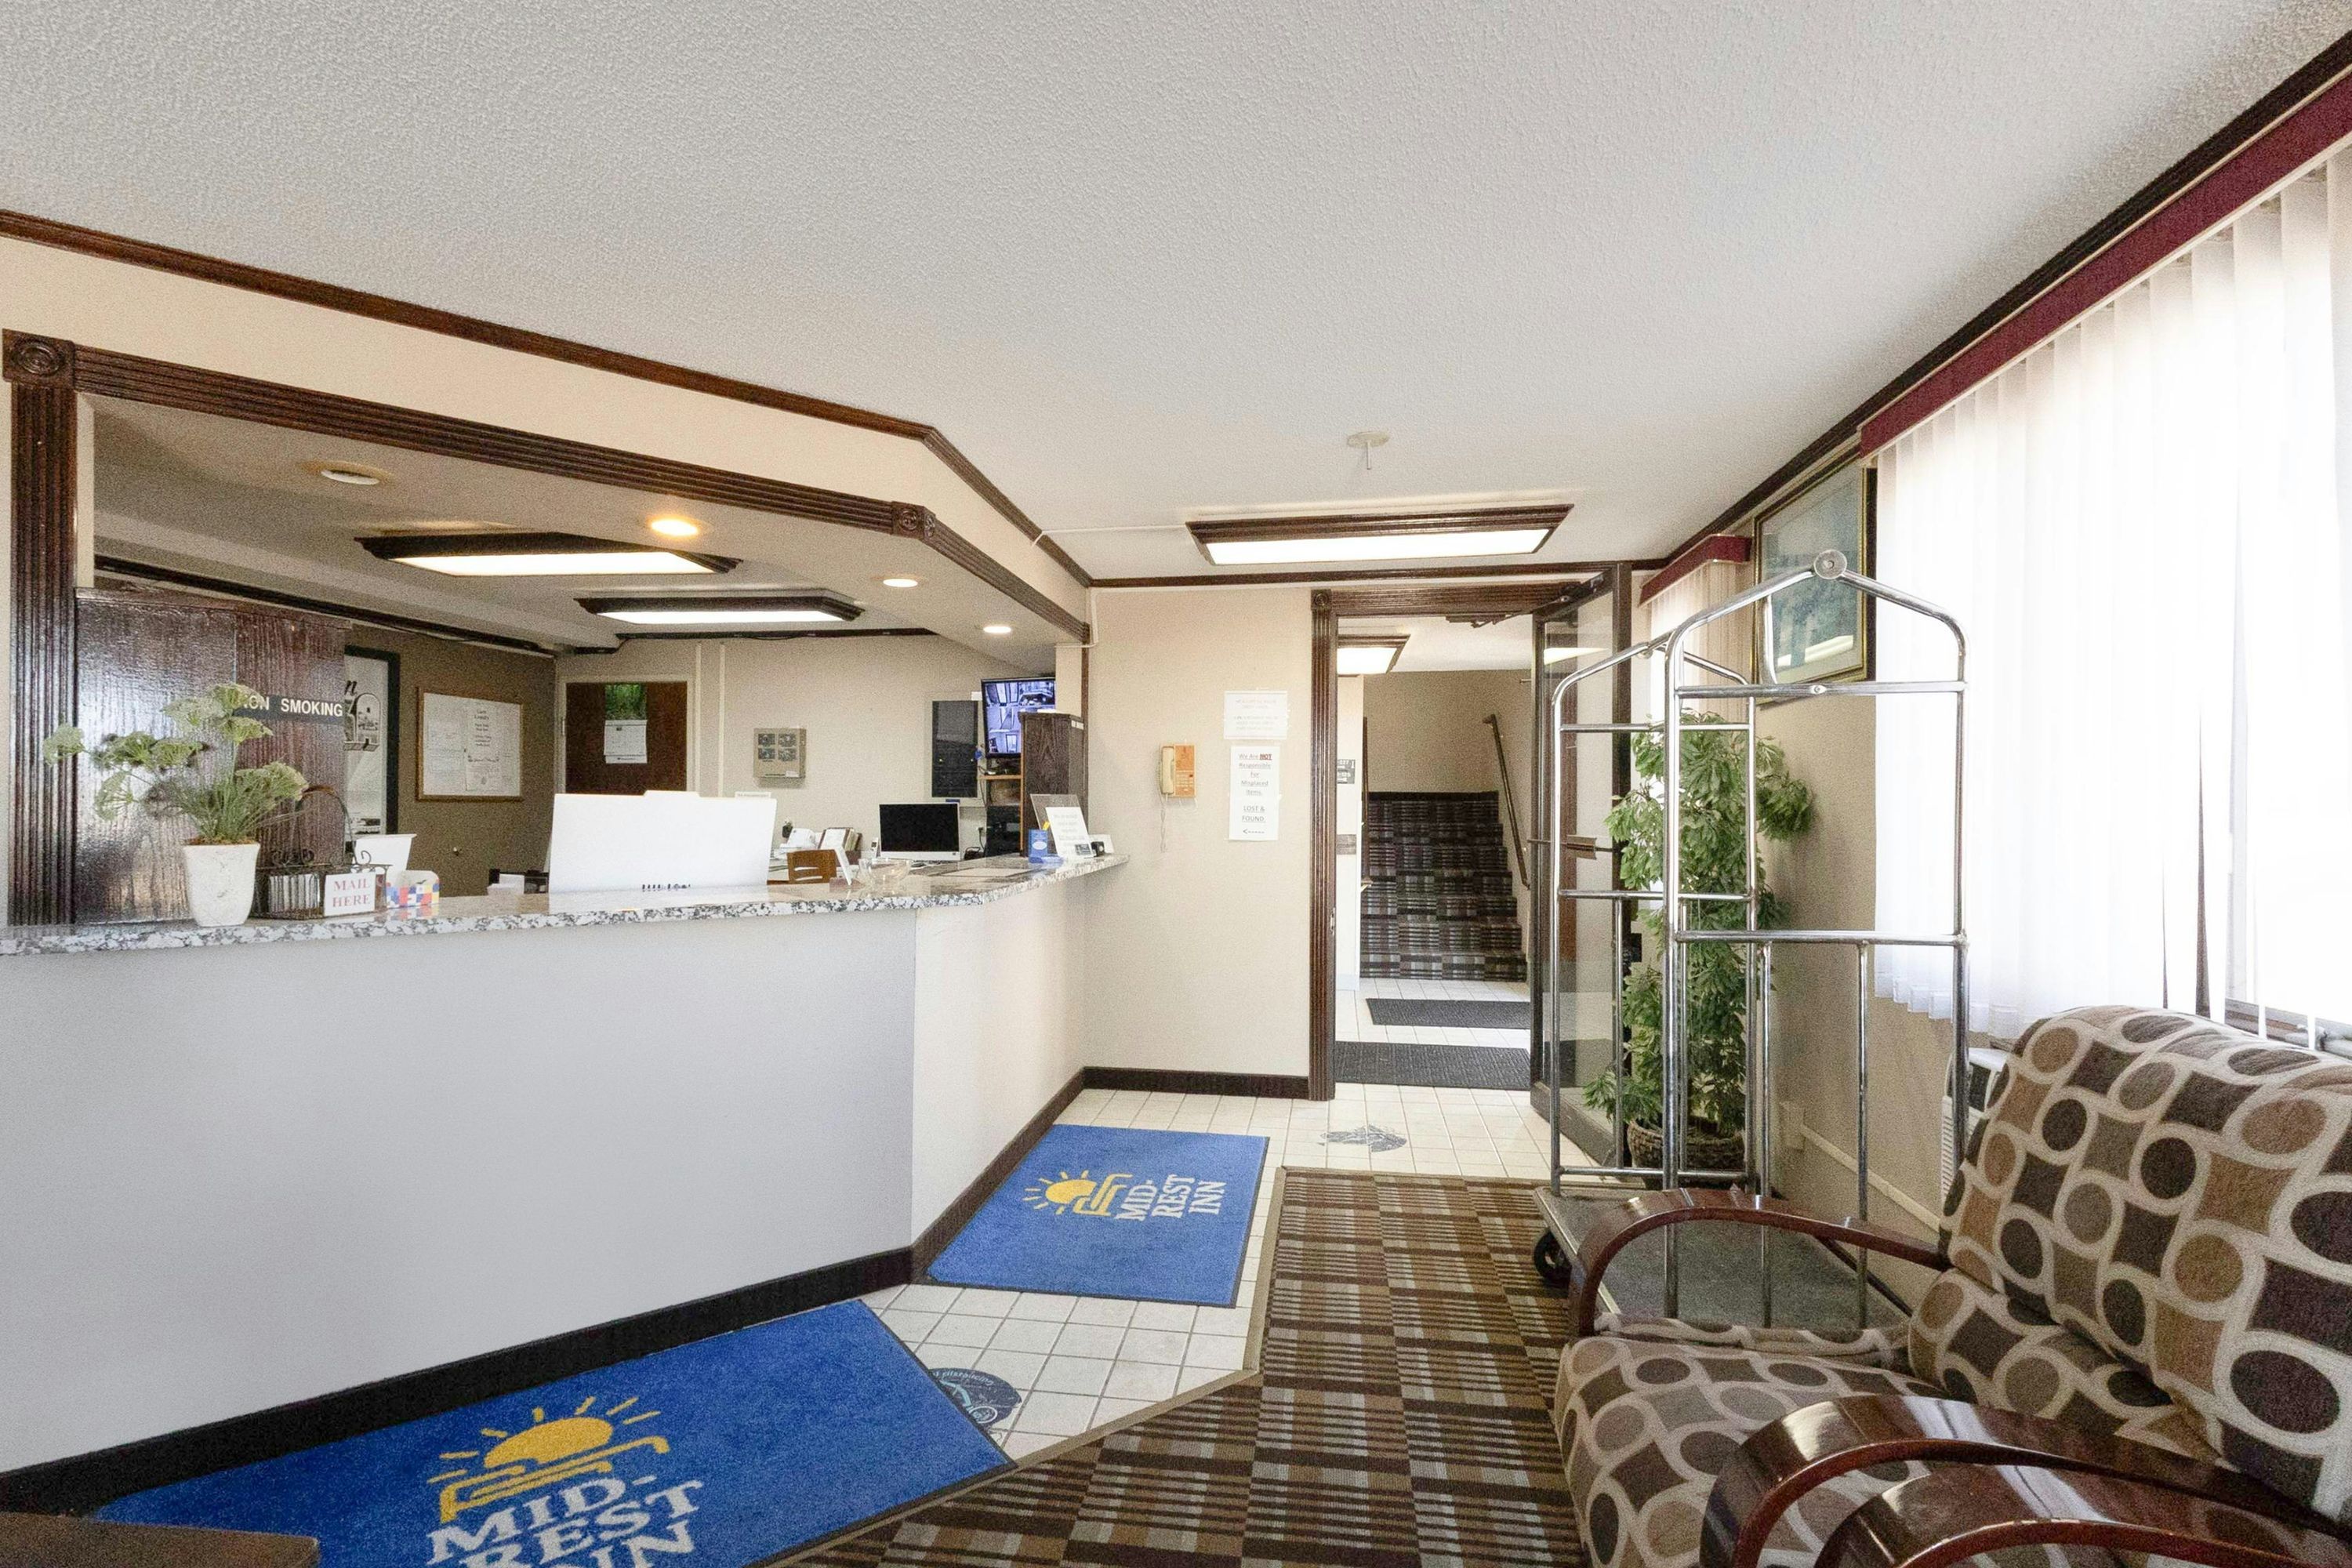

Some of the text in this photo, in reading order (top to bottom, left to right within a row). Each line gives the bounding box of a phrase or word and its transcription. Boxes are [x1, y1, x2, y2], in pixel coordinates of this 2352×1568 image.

[242, 695, 343, 717] ON SMOKING
[332, 894, 371, 908] HERE
[333, 878, 370, 891] MAIL
[1113, 1179, 1158, 1221] MID-
[1151, 1174, 1196, 1218] REST
[1189, 1180, 1227, 1215] INN
[426, 1475, 657, 1566] MID-
